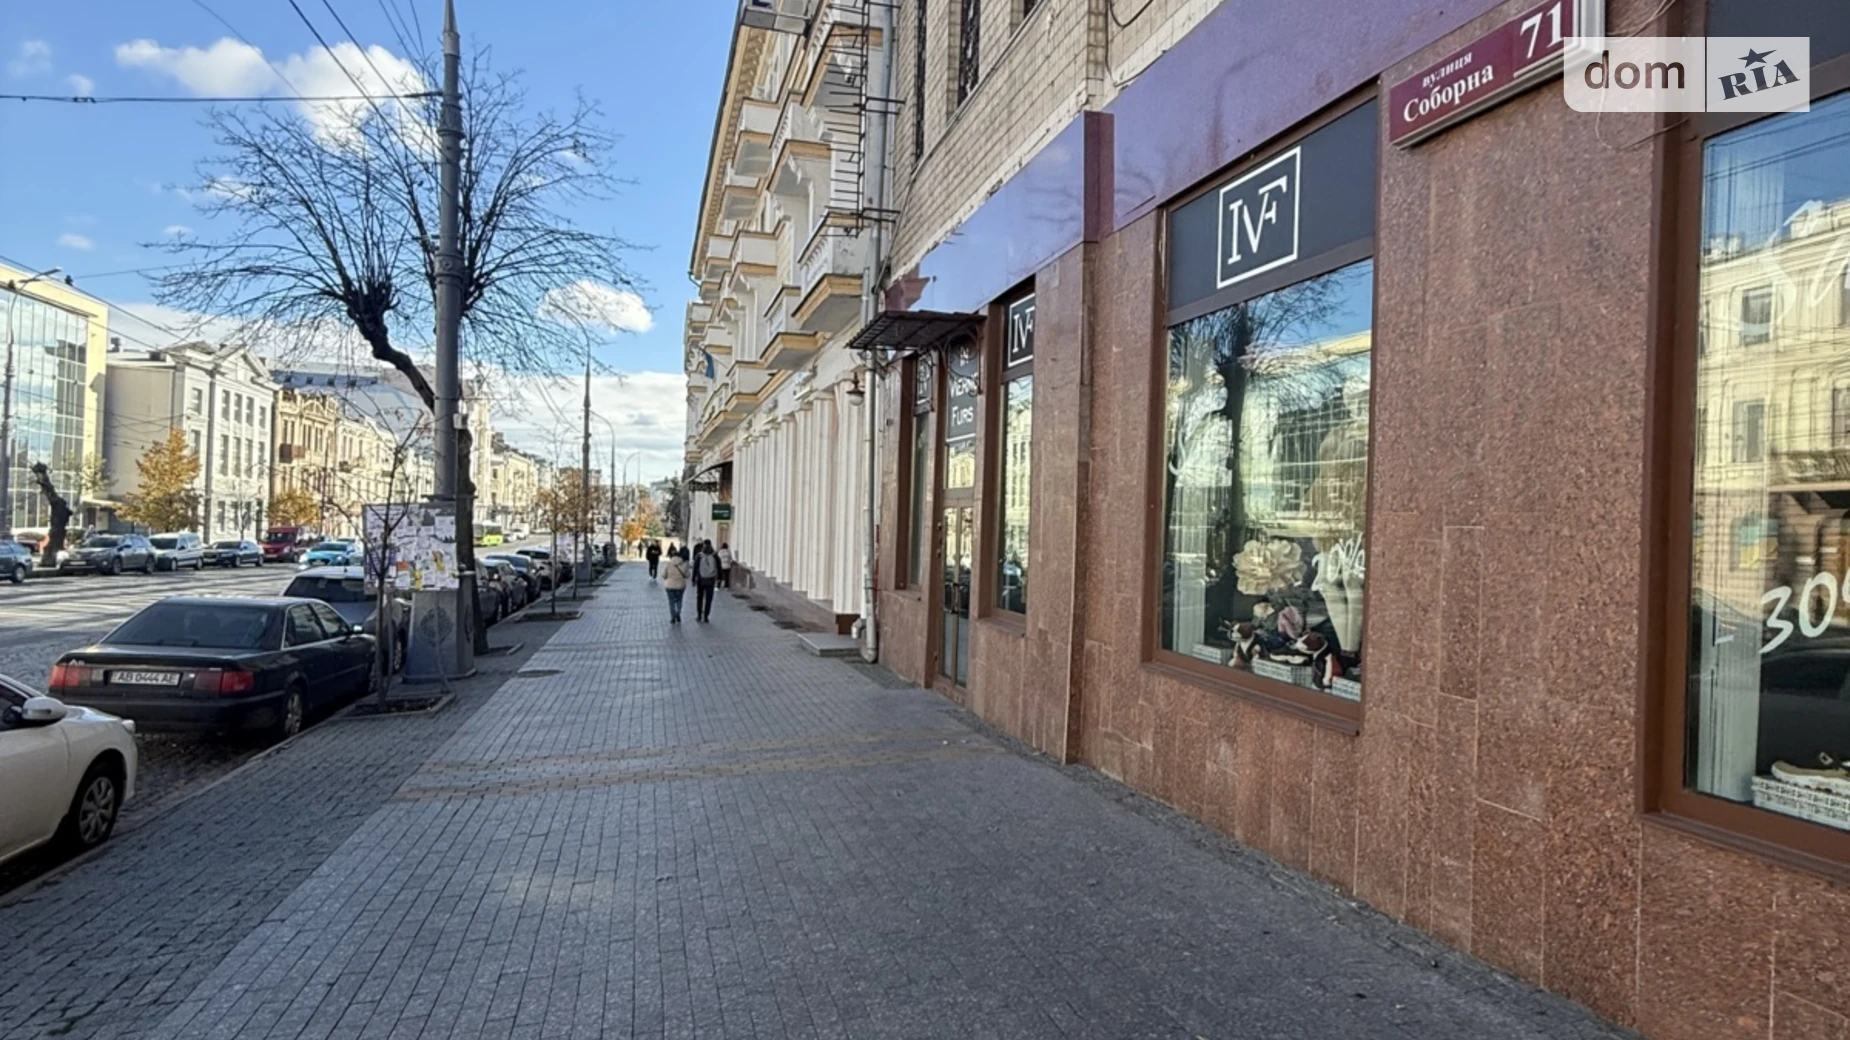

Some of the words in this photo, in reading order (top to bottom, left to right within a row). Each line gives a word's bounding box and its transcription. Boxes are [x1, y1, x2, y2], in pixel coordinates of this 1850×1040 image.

[1519, 1, 1565, 59] 71
[1403, 64, 1494, 122] Соборна
[1422, 51, 1473, 88] вулиця
